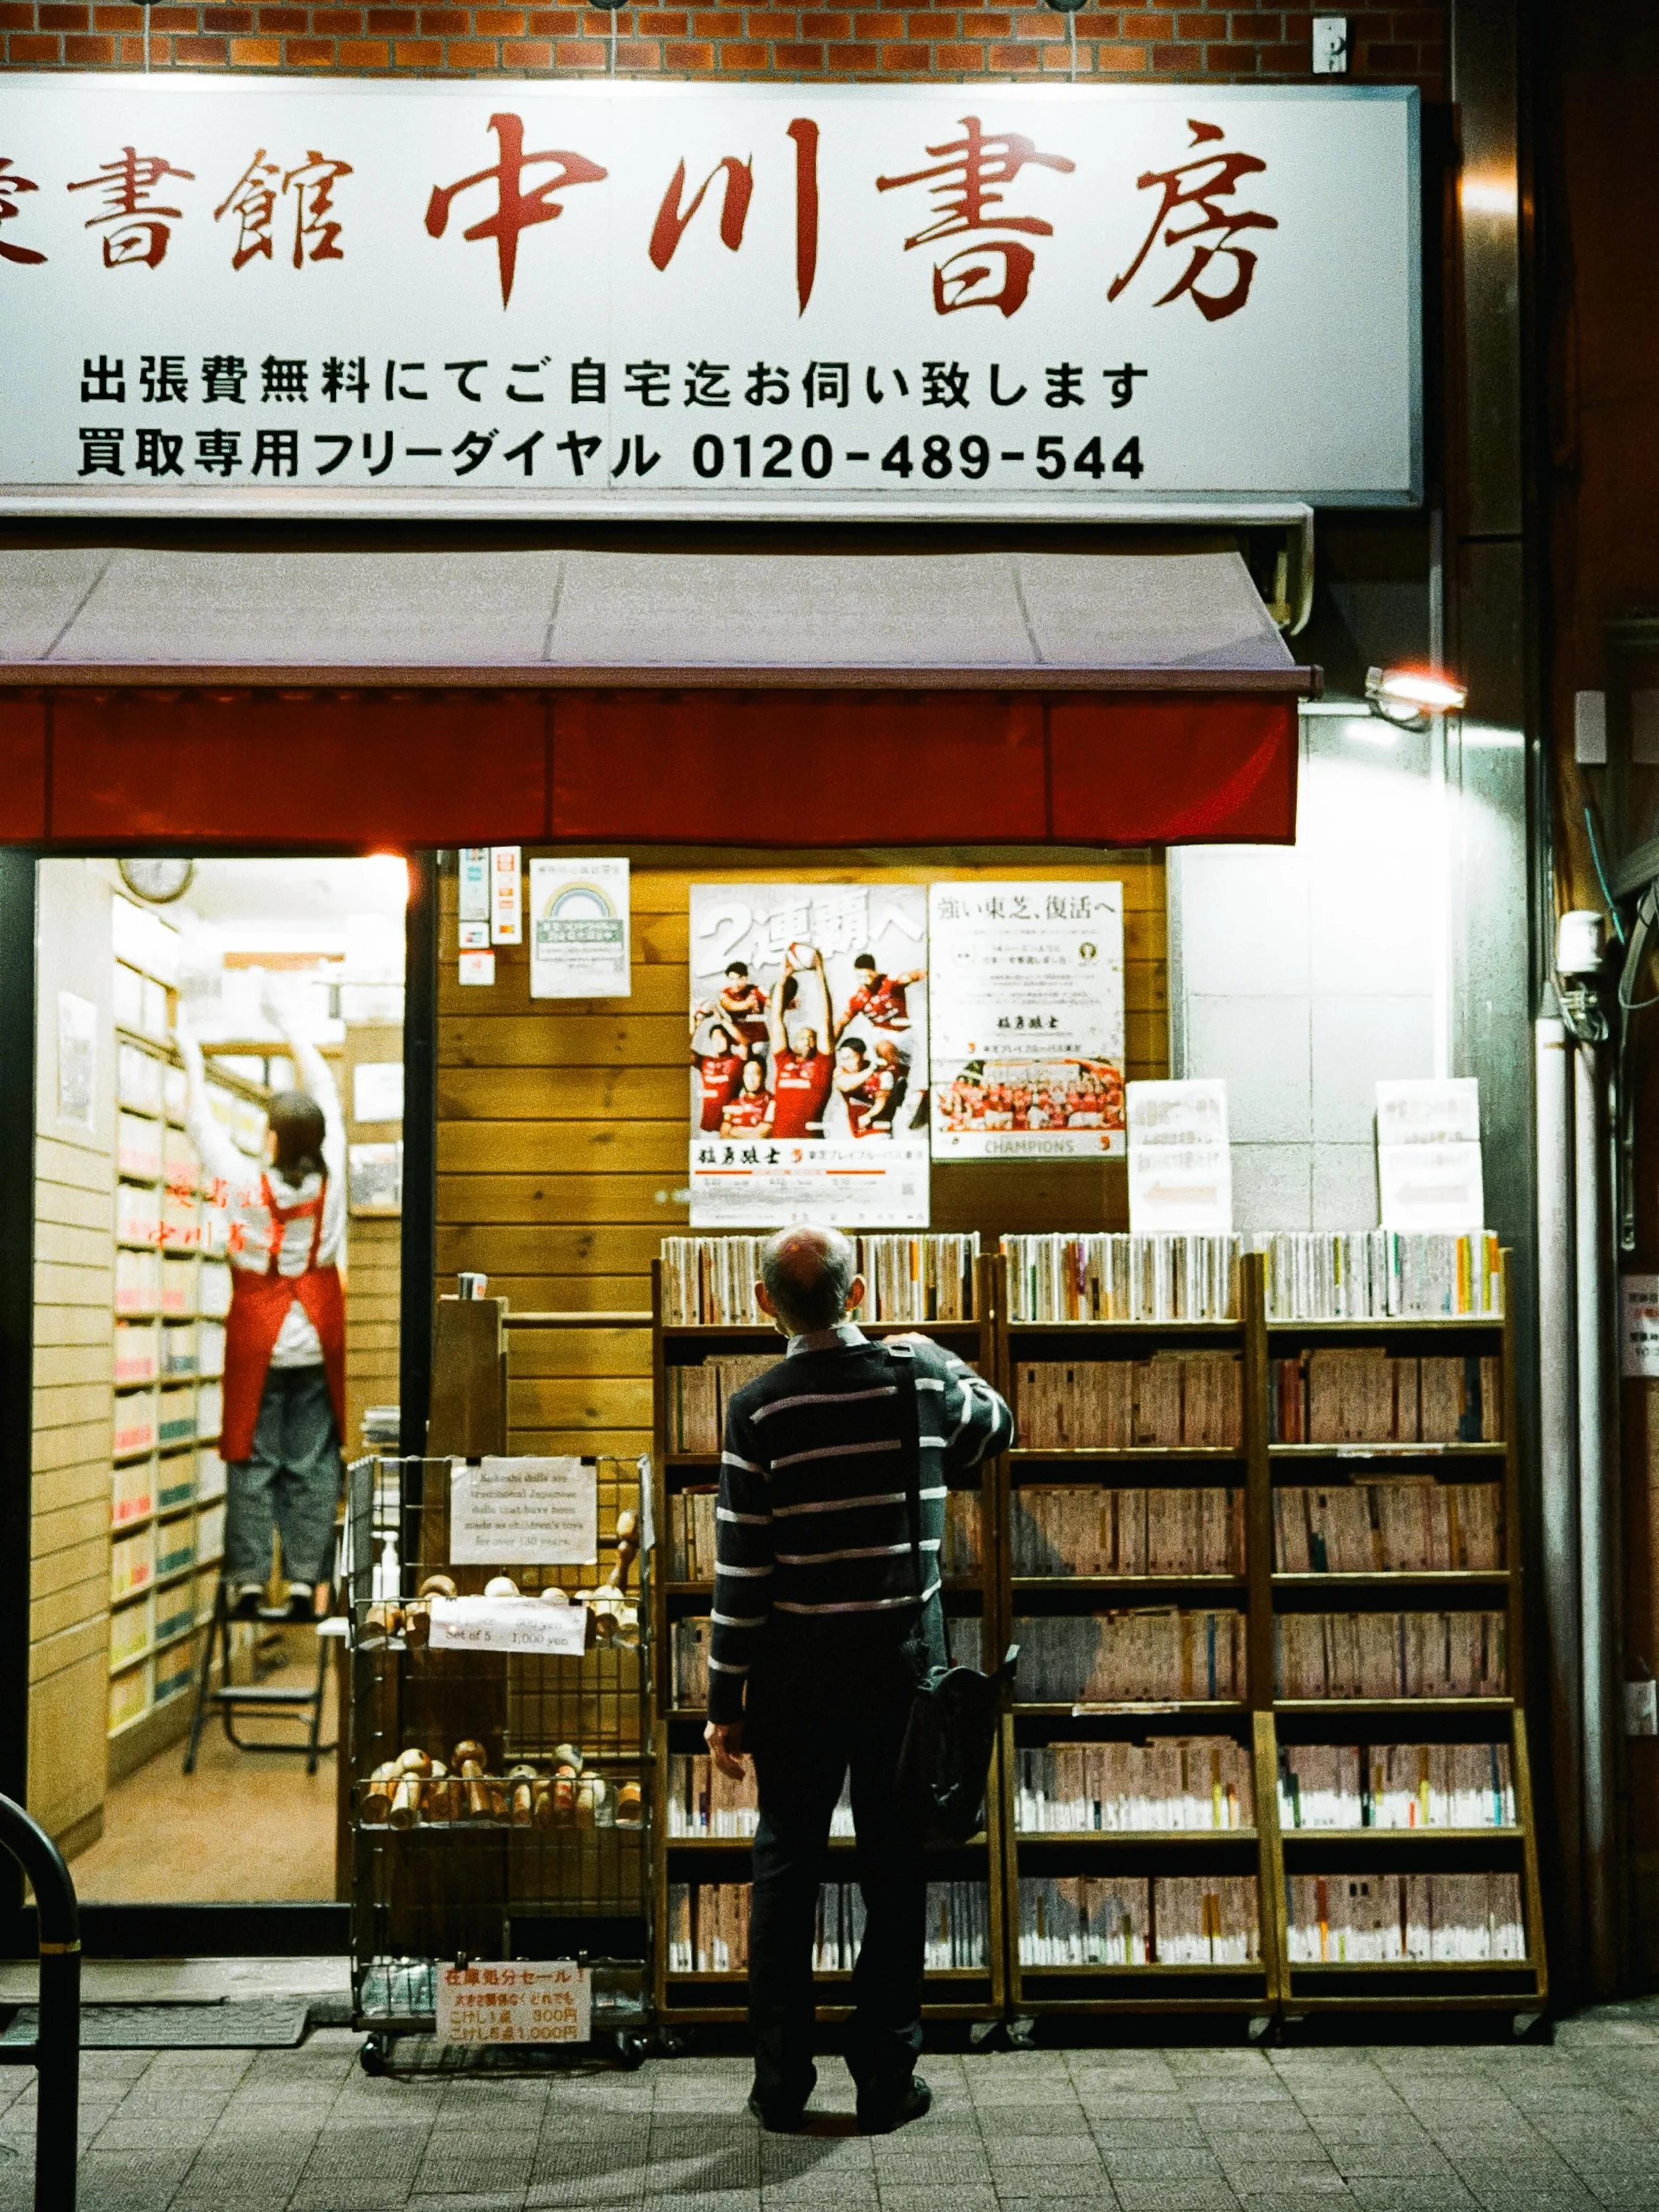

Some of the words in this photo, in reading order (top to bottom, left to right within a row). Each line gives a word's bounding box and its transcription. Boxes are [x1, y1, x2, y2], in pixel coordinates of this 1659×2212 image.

[425, 113, 1278, 321] 中川書房
[79, 354, 1149, 409] 出張費無料にてご自宅迄お伺い致します
[78, 426, 661, 478] 買取専用フリーダイヤル
[693, 433, 1145, 480] 0120-489-544
[938, 895, 1116, 920] 強い東芝、復活へ
[985, 1140, 1074, 1153] CHAMPIONS
[469, 1630, 481, 1641] of
[547, 1635, 569, 1647] yen
